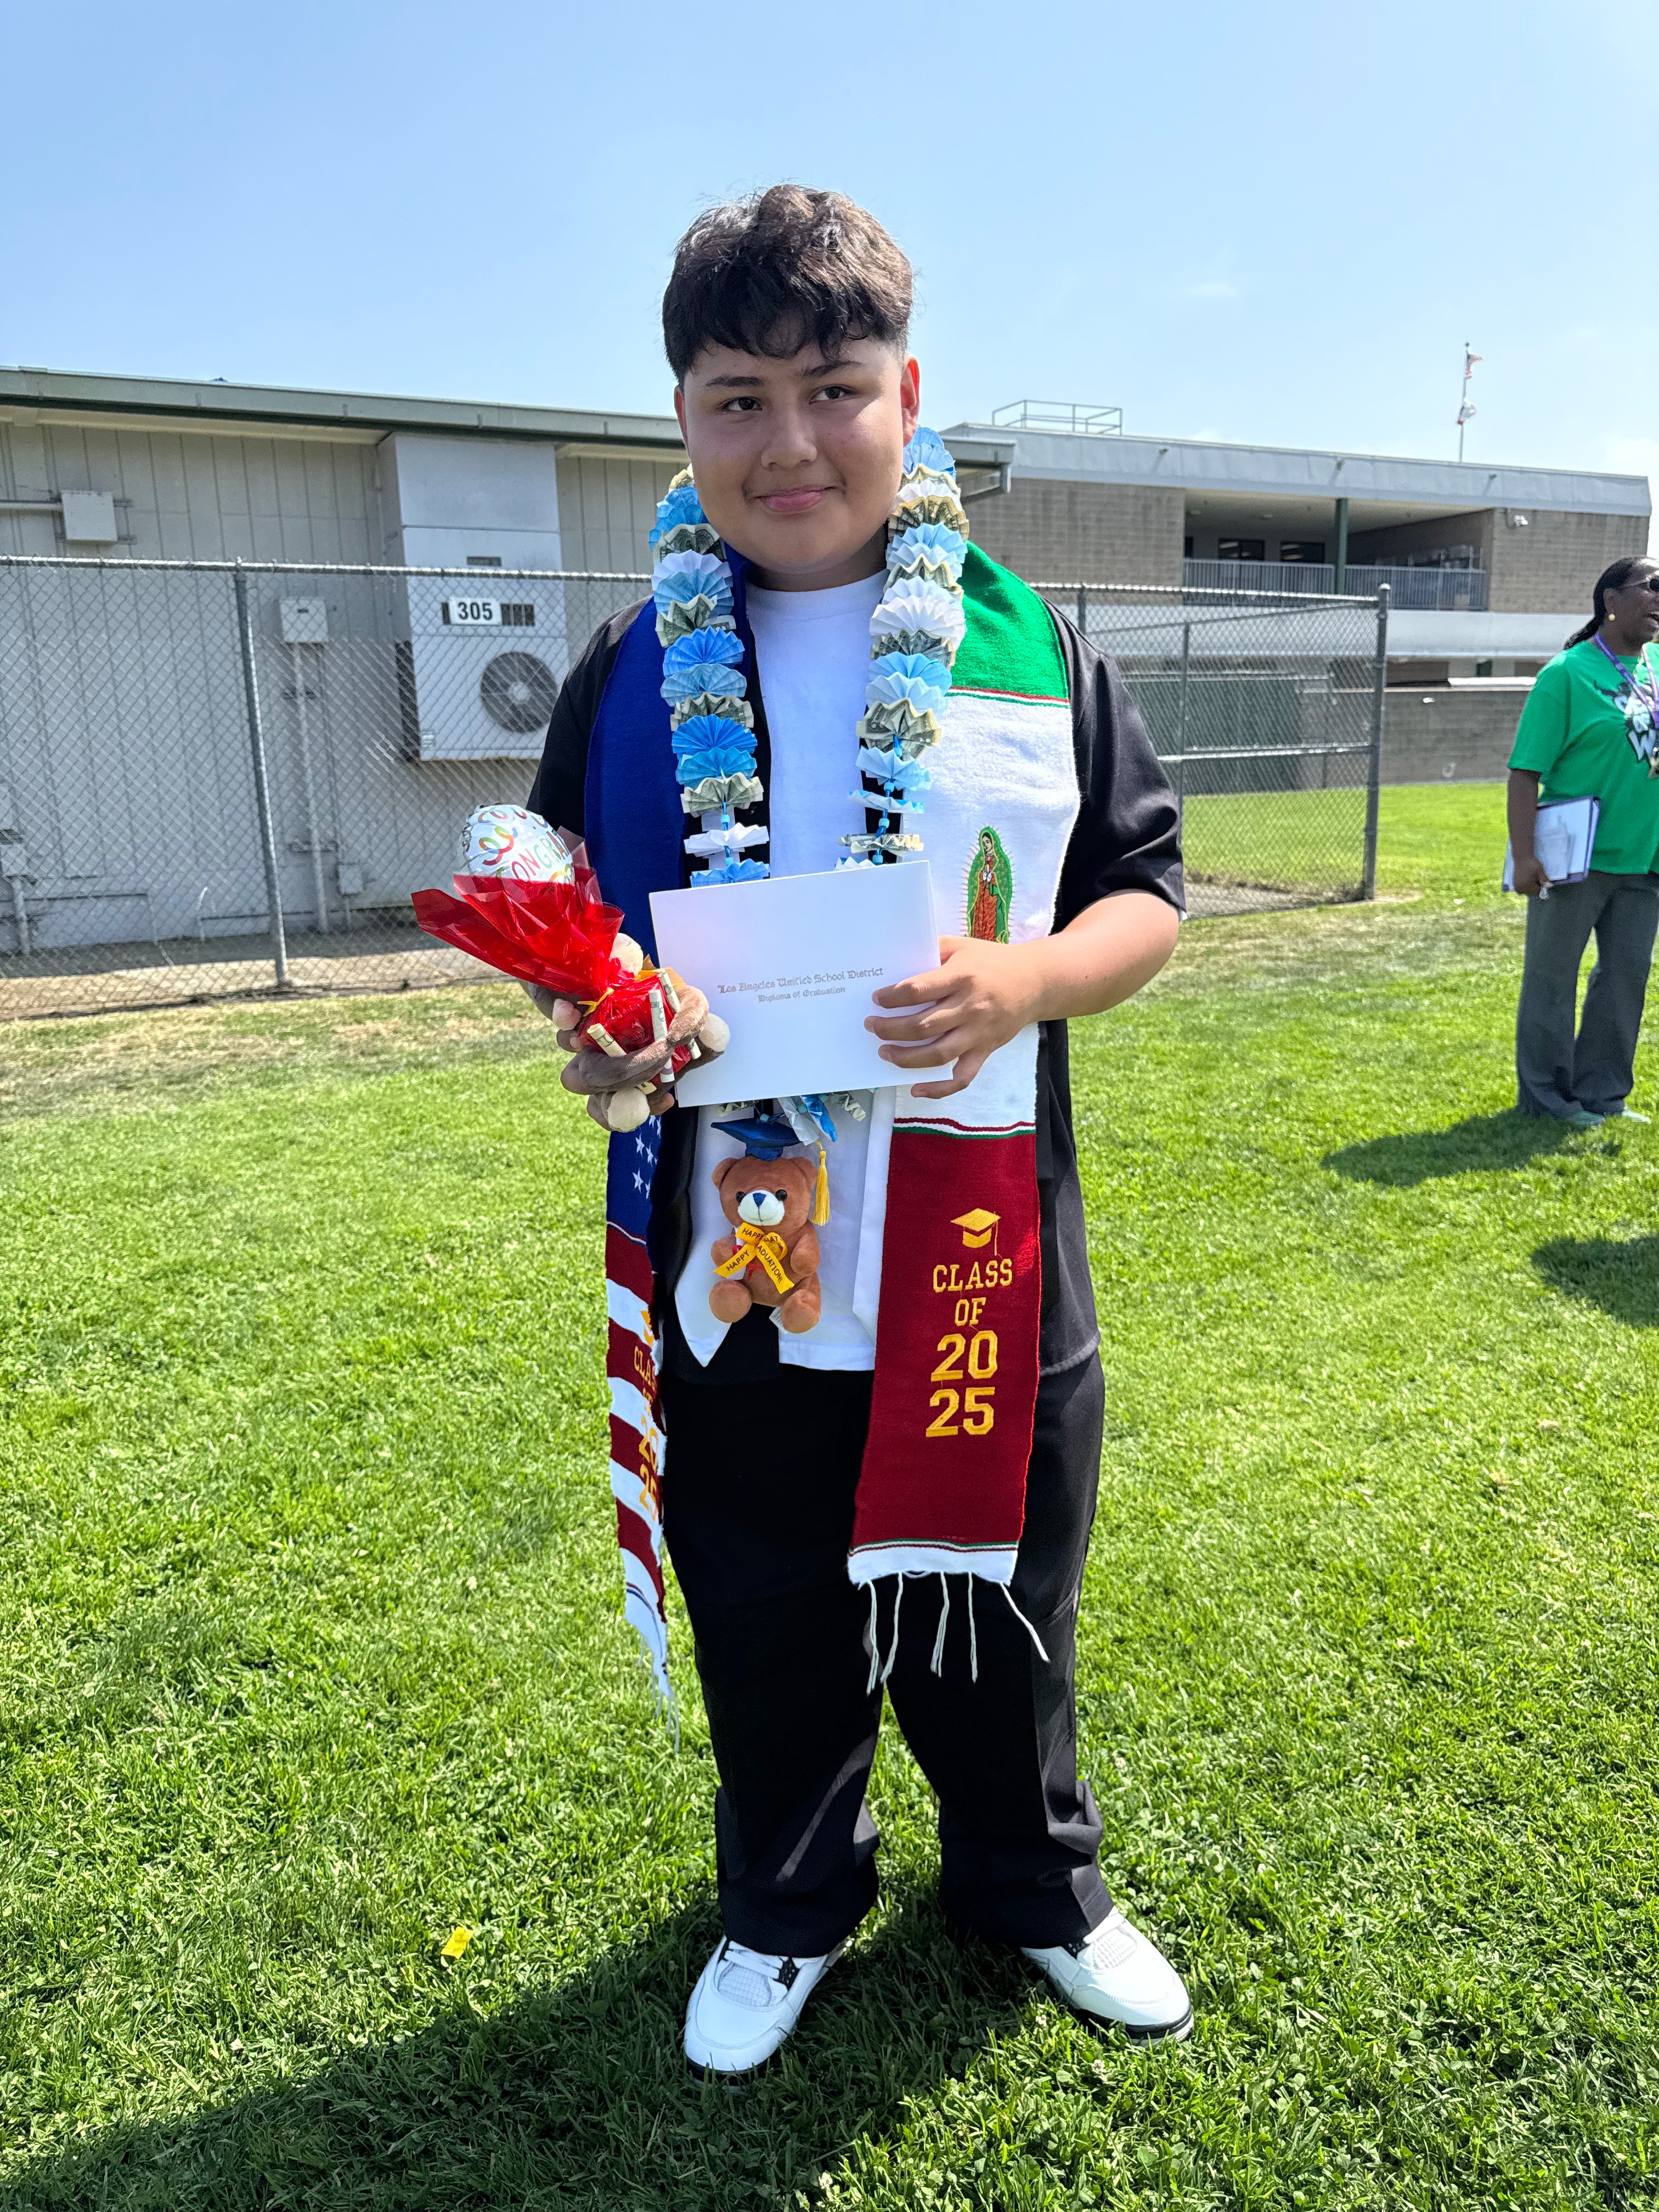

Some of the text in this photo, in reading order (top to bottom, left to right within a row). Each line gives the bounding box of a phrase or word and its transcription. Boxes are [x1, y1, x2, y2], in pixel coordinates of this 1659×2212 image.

[458, 601, 493, 620] 305
[717, 967, 884, 994] Los Angeles Unified School District
[758, 992, 792, 1003] Diploma
[803, 987, 846, 997] Graduation
[726, 1249, 749, 1272] HAPPY
[933, 1258, 1013, 1293] CLASS
[954, 1297, 987, 1327] OF
[930, 1330, 998, 1383] 20
[926, 1386, 996, 1438] 25
[639, 1413, 659, 1475] 20
